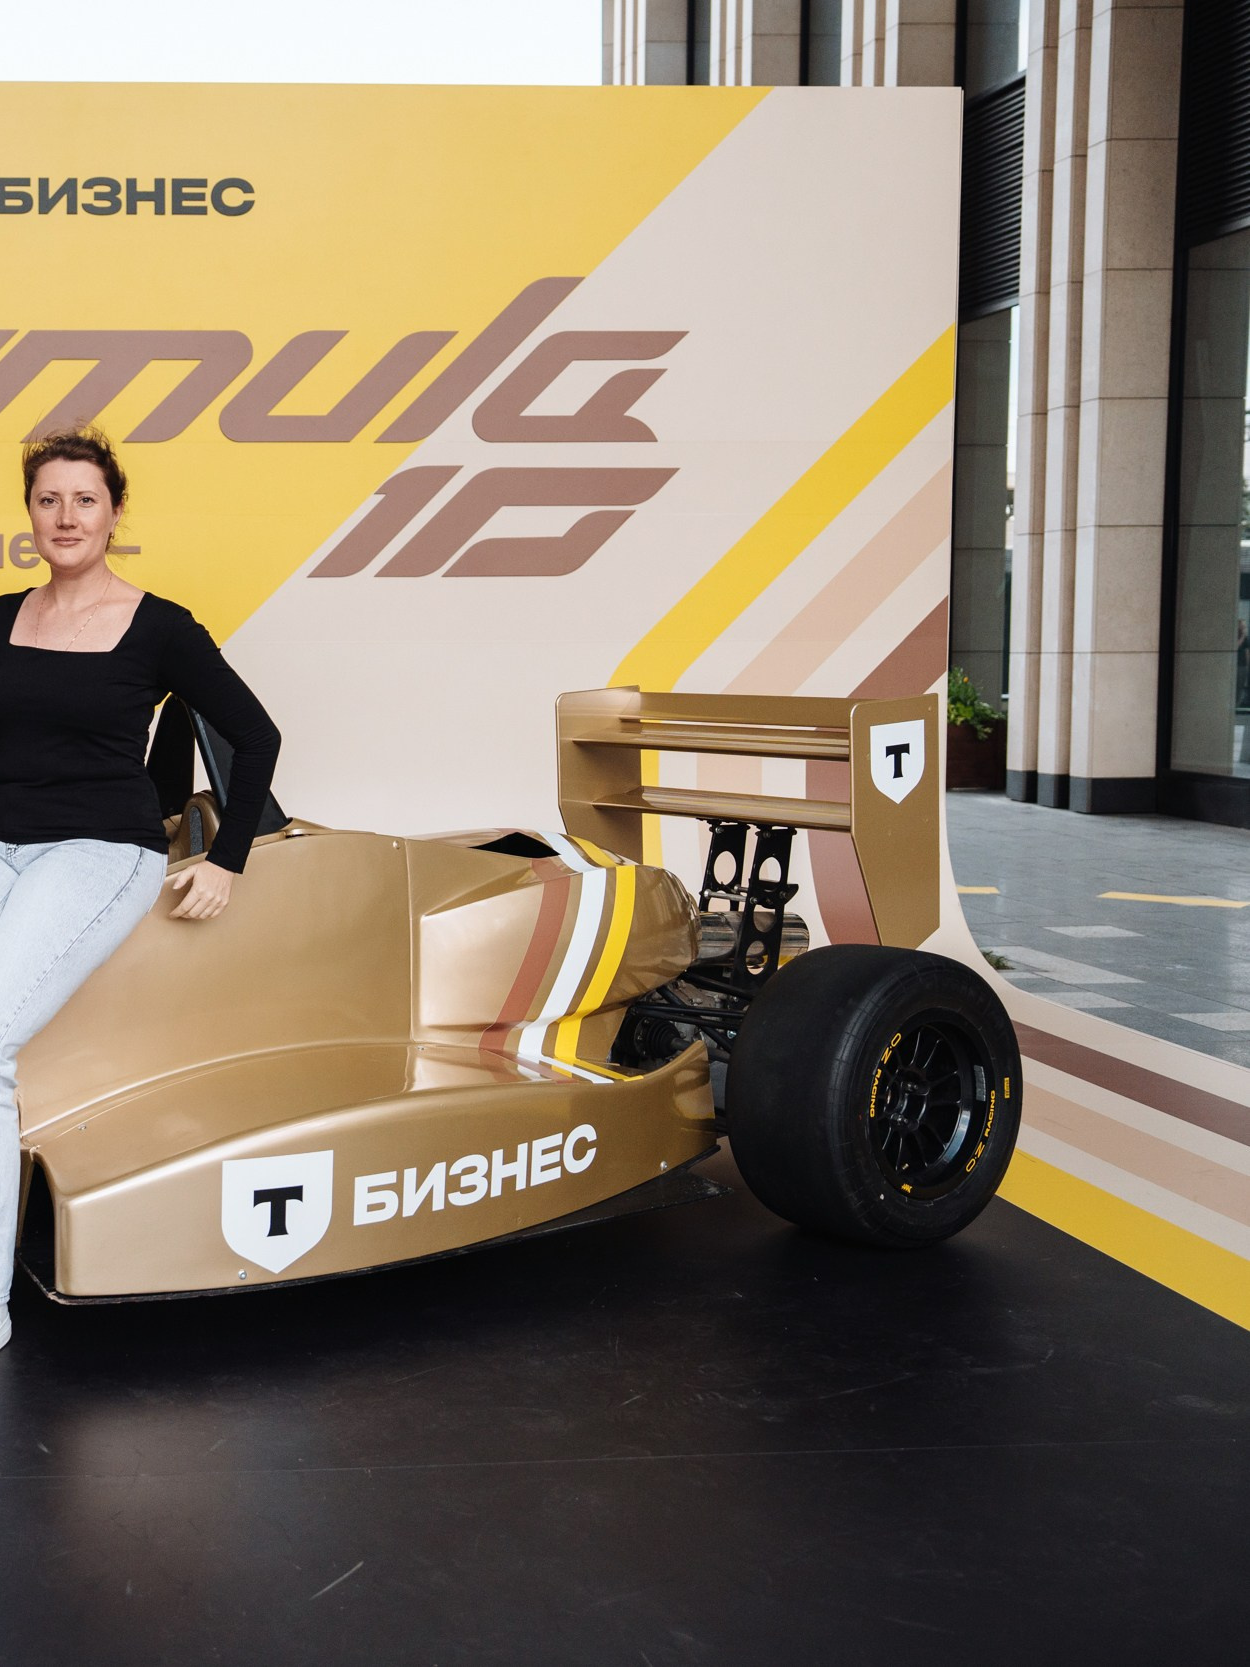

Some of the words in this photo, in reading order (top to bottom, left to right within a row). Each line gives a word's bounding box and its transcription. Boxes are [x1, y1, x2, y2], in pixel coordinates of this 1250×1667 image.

[306, 464, 681, 578] 10
[869, 1068, 883, 1118] RACING
[984, 1089, 996, 1138] RACING
[352, 1123, 598, 1227] БИЗНЕС
